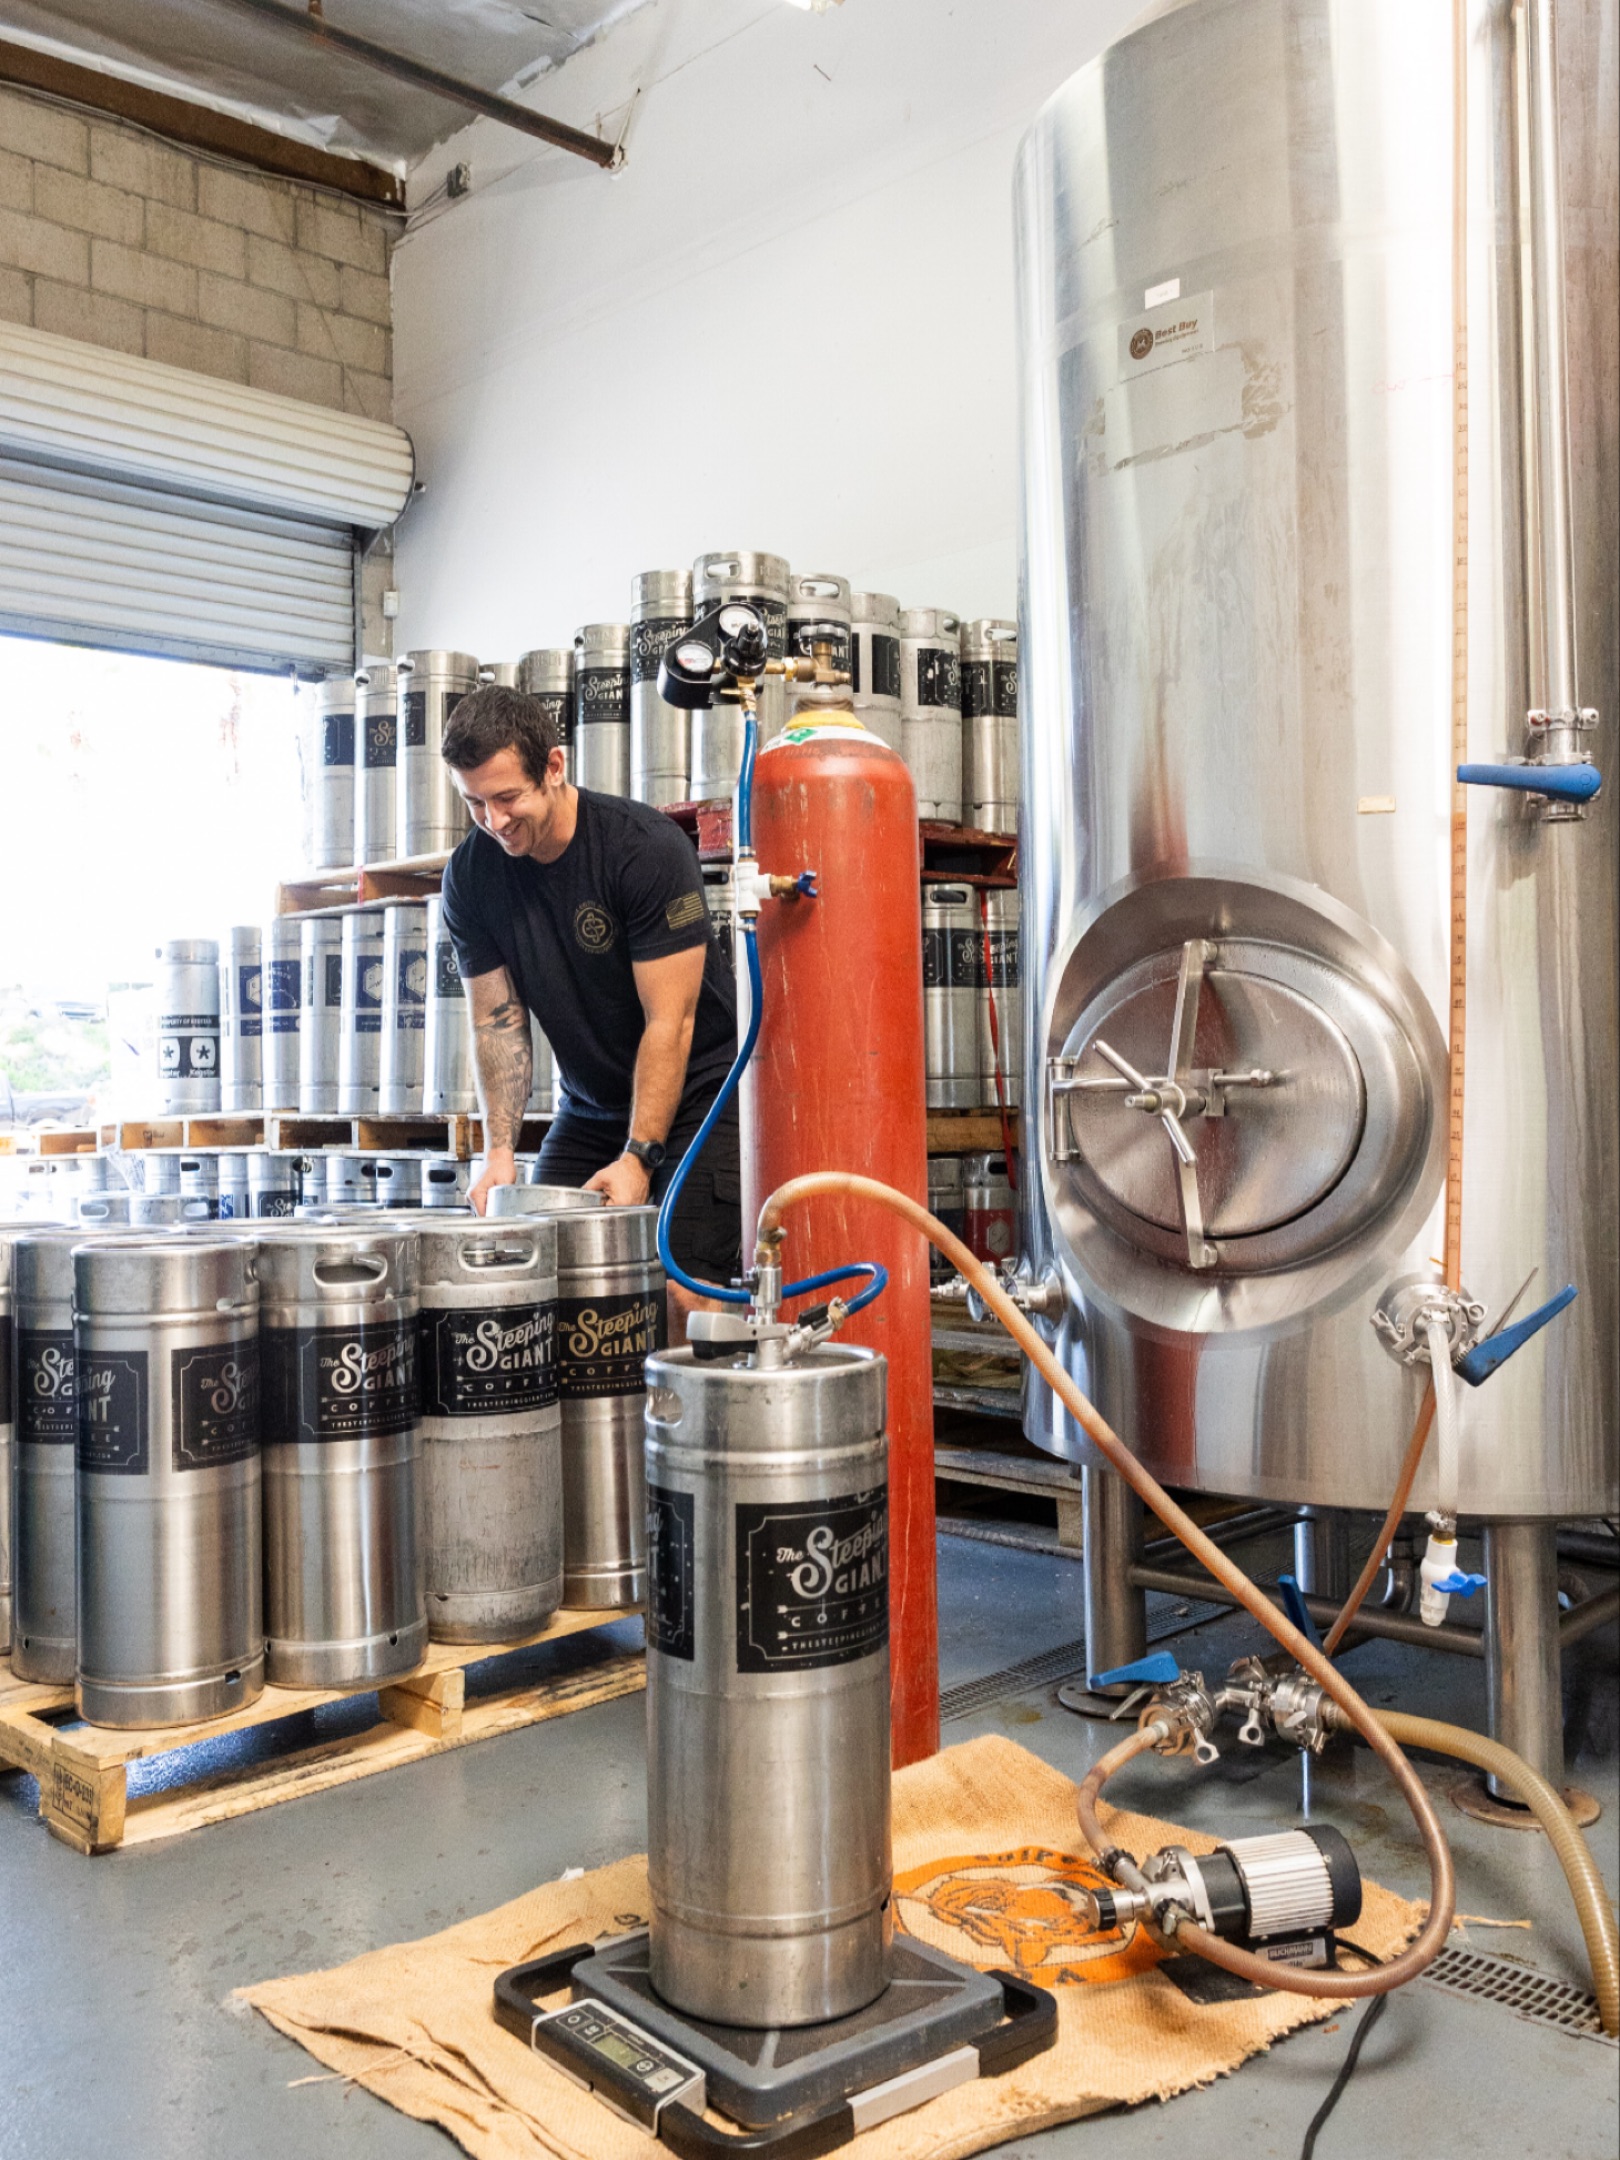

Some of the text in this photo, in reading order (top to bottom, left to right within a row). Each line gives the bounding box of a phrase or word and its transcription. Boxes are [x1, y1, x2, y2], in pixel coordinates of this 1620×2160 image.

[1155, 325, 1176, 340] Best
[1179, 319, 1198, 331] Buy
[598, 689, 623, 700] GIAN
[454, 1312, 555, 1371] The Steeping
[569, 1302, 658, 1358] Steeping
[601, 1325, 657, 1357] GIANT
[319, 1357, 340, 1368] The
[501, 1336, 553, 1370] GIANT
[362, 1359, 414, 1390] GIANT
[776, 1509, 887, 1598] The Steepin
[791, 1597, 880, 1628] COFFE
